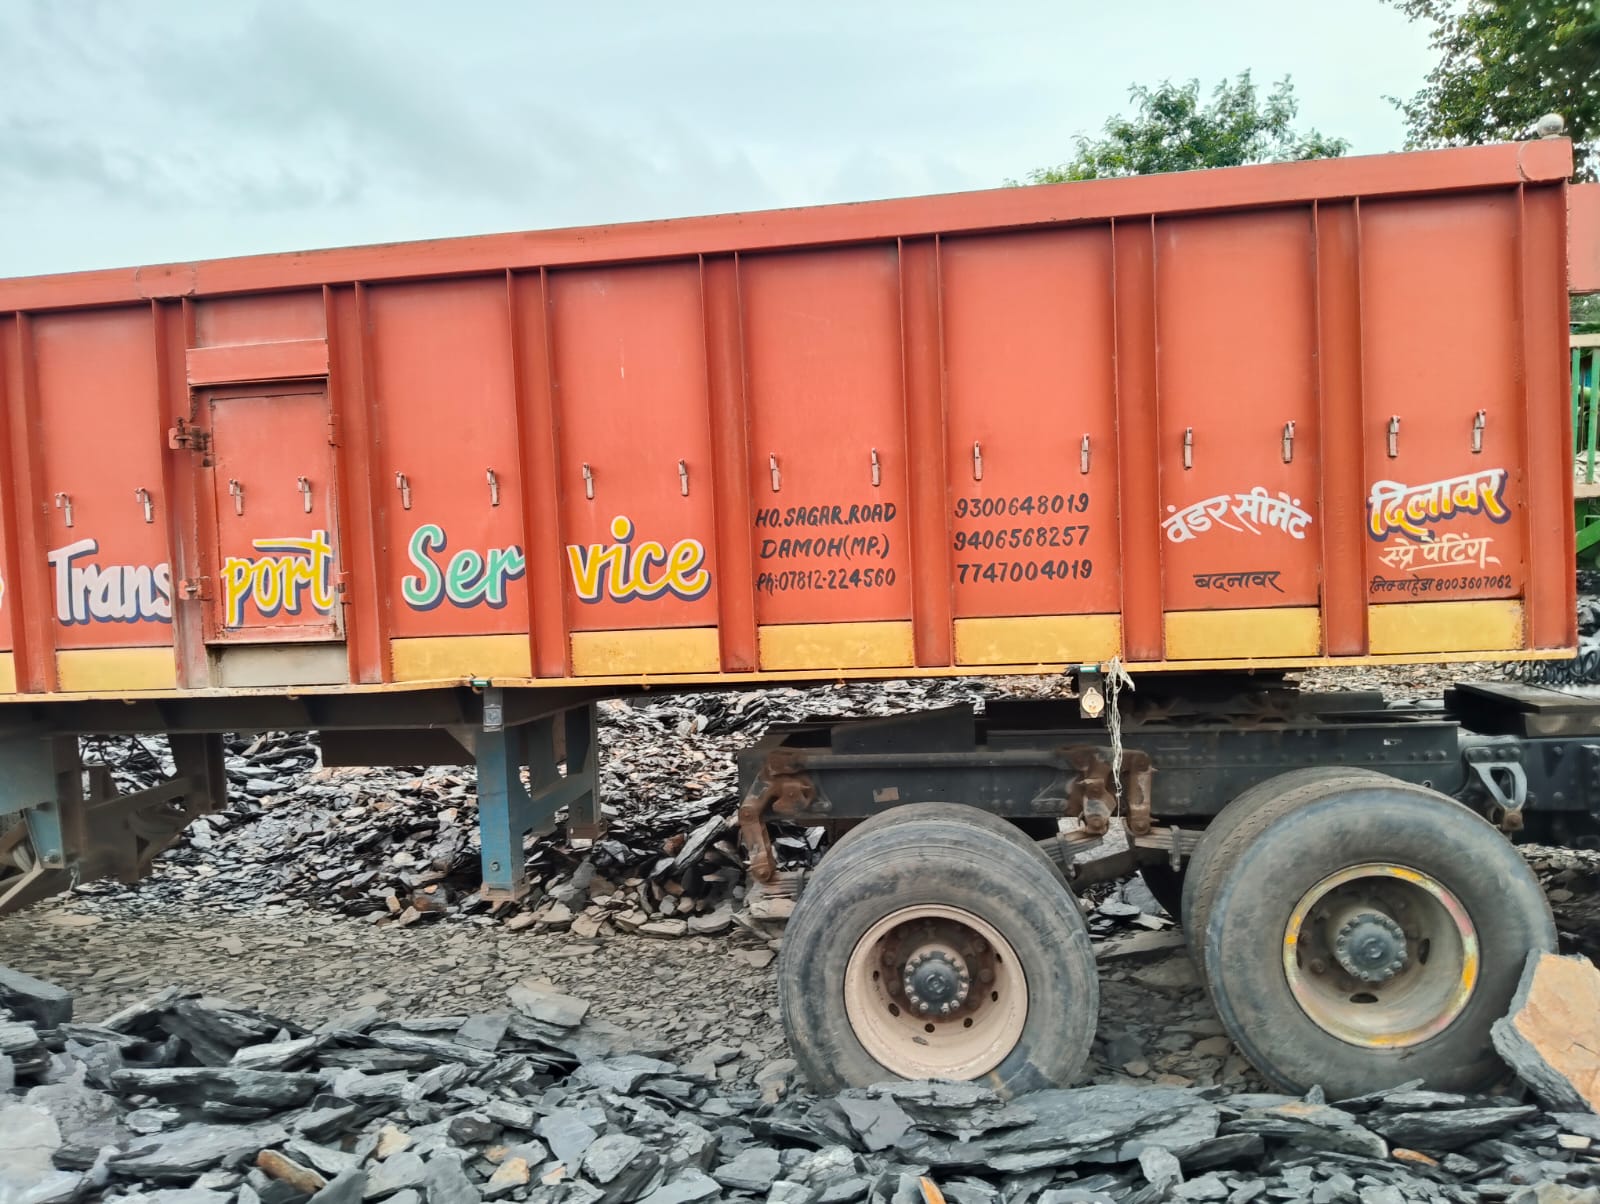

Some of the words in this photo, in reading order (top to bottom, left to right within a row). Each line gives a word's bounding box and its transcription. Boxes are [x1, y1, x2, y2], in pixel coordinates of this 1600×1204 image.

[954, 493, 1089, 518] 9300648019
[1161, 494, 1244, 543] वंडर
[1231, 486, 1313, 539] सीमेंट
[1366, 468, 1512, 542] दिलावर
[953, 525, 1090, 551] 9406568257
[48, 538, 172, 626] Trans
[221, 529, 334, 632] port
[402, 524, 525, 611] Ser
[566, 515, 712, 604] vice
[957, 559, 1093, 584] 7747004019
[1193, 571, 1285, 593] बदनावर
